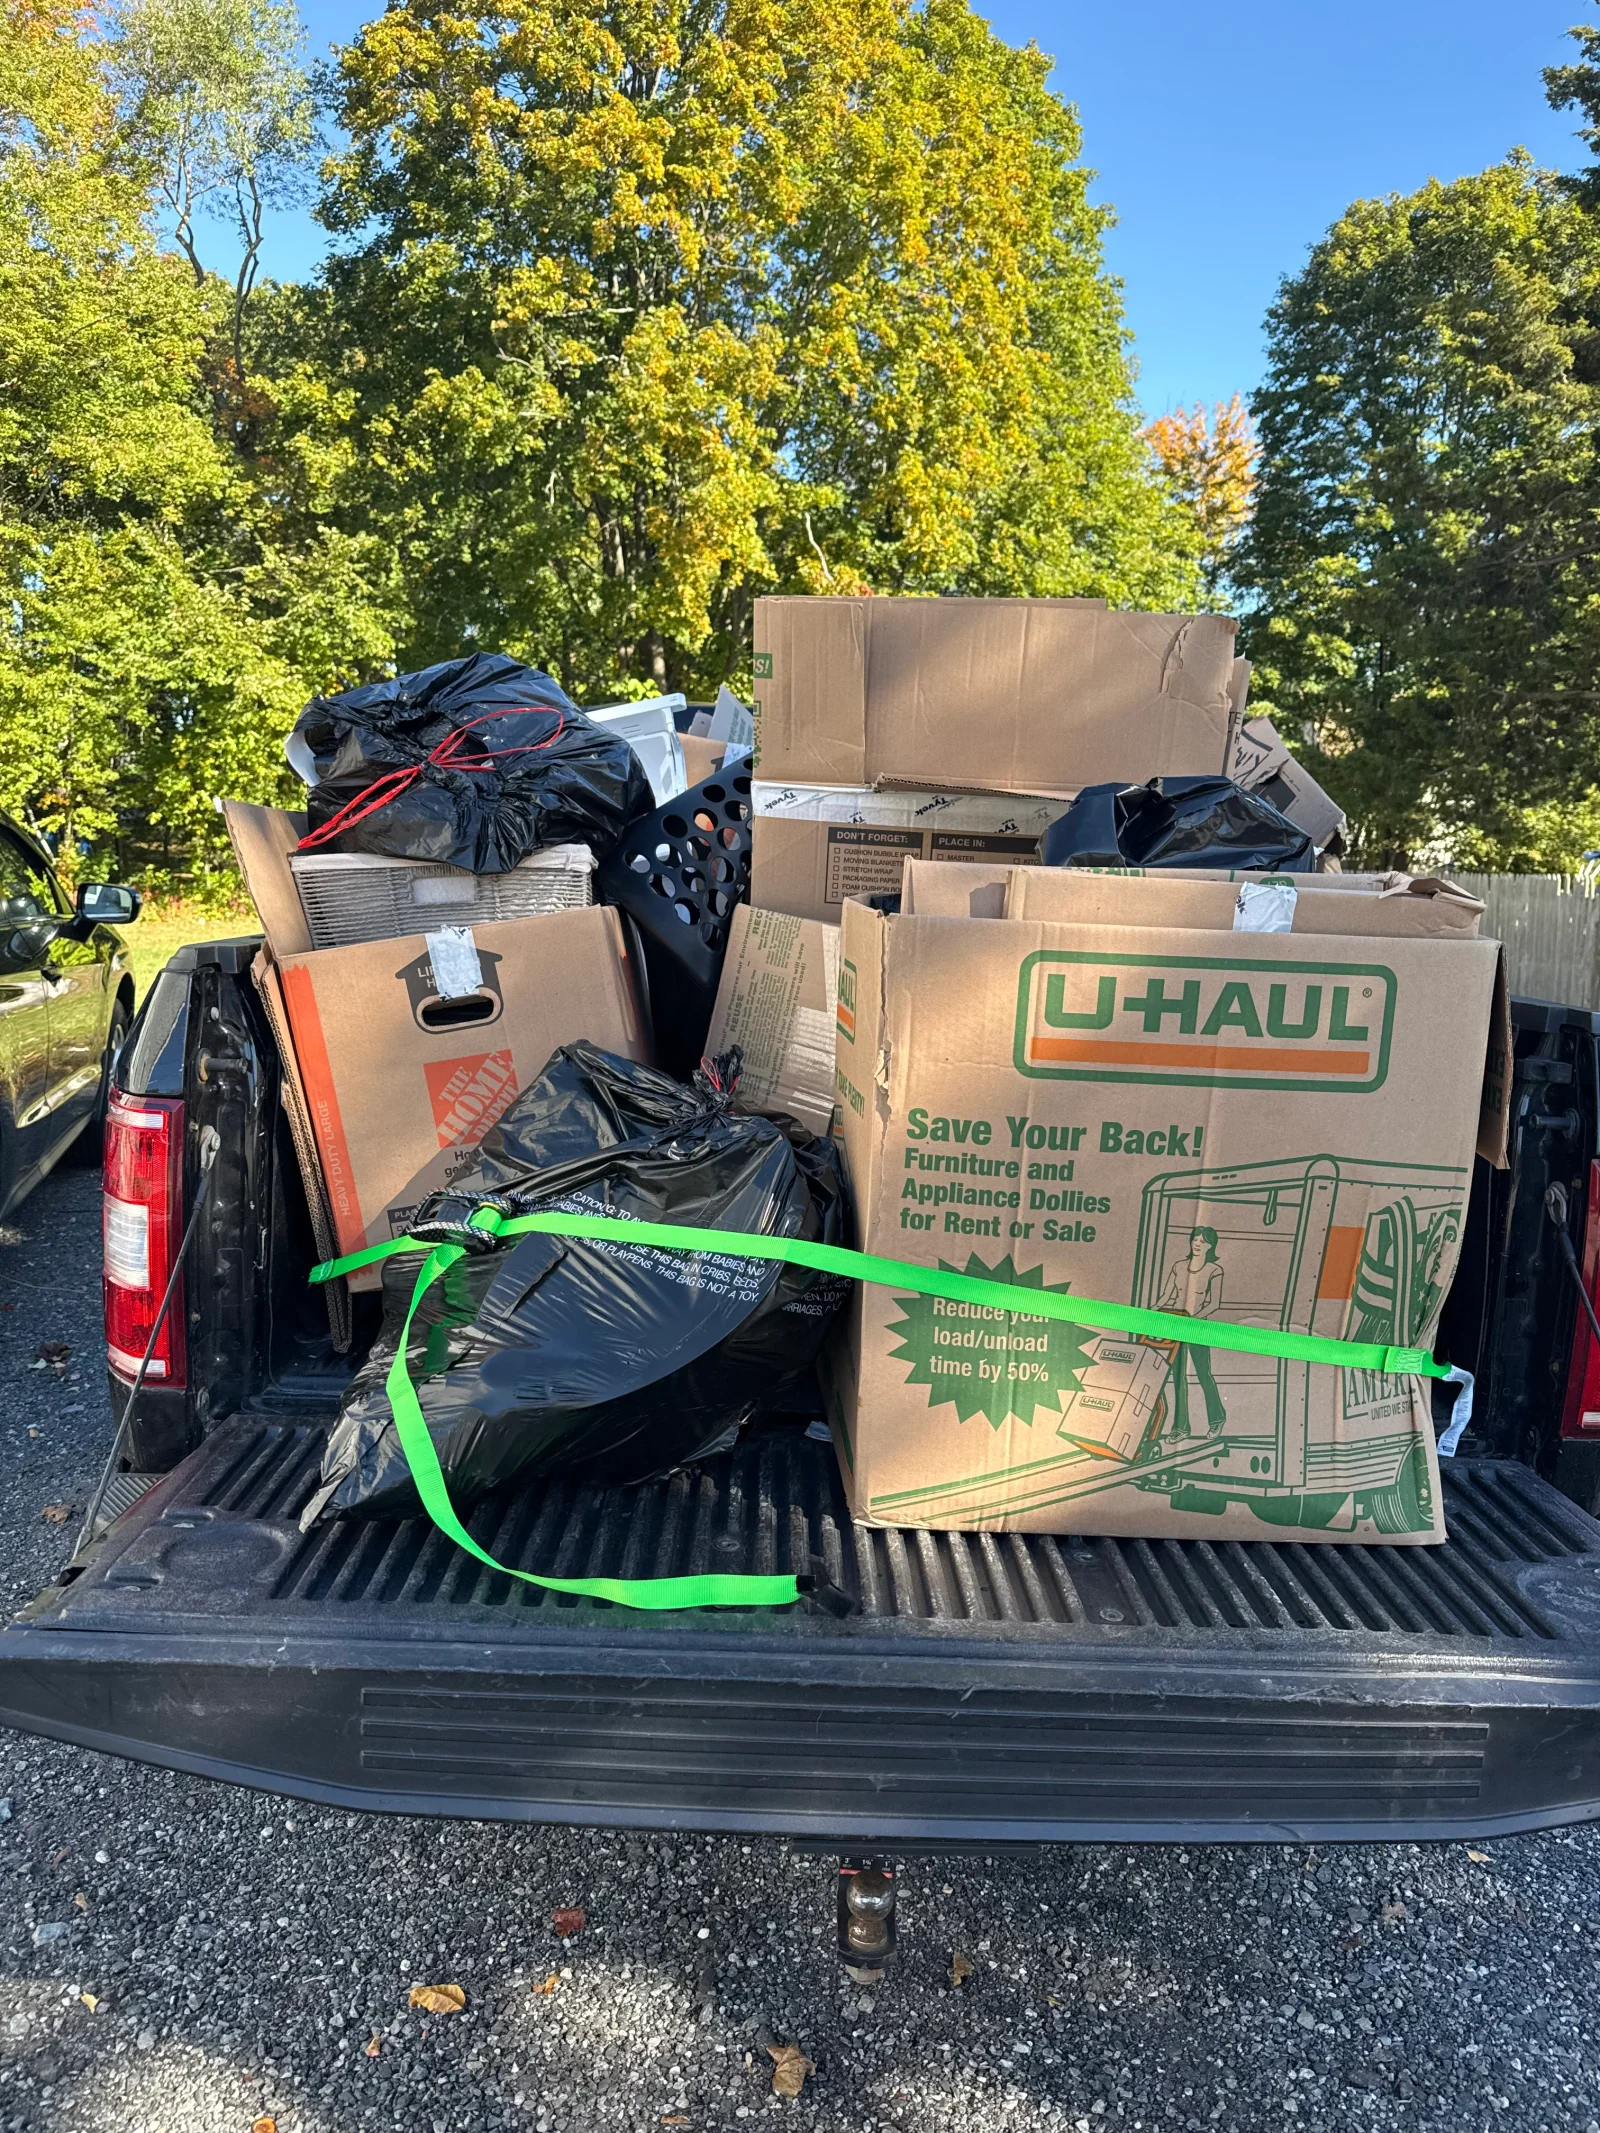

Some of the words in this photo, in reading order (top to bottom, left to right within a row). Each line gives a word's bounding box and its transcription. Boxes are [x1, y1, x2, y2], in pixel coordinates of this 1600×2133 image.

[837, 831, 864, 841] DON'T
[868, 834, 908, 844] FORGET:
[844, 848, 872, 856] CUSHION
[874, 850, 899, 858] BUBBLE
[939, 837, 970, 847] PLACE
[973, 839, 985, 847] IN:
[843, 857, 869, 865] MOVING
[871, 859, 904, 867] BLANKETS
[1023, 858, 1040, 866] KITC
[730, 994, 744, 1032] REUSE
[764, 1081, 773, 1104] orking
[778, 1019, 787, 1044] U-Haul
[783, 976, 797, 1017] Customers
[437, 1052, 515, 1146] HOME
[439, 1066, 472, 1104] THE
[318, 1101, 334, 1140] LARGE
[906, 1107, 992, 1146] Save
[1006, 1115, 1087, 1151] Your
[1099, 1121, 1204, 1158] Back!
[327, 1144, 342, 1176] DUTY
[904, 1147, 1020, 1178] Furniture
[1027, 1159, 1075, 1182] and
[335, 1182, 351, 1216] HEAVY
[901, 1177, 1021, 1209] Appliance
[1030, 1188, 1111, 1214] Dollies
[900, 1207, 936, 1231] for
[944, 1211, 1001, 1238] Rent
[1009, 1220, 1034, 1240] or
[1042, 1218, 1096, 1243] Sale
[592, 1239, 608, 1252] OR
[606, 1243, 652, 1270] PLAYPENS.
[655, 1264, 679, 1281] THIS
[676, 1274, 697, 1288] BAG
[696, 1277, 707, 1289] IS
[706, 1281, 731, 1296] NOT
[727, 1290, 737, 1300] A
[739, 1291, 759, 1303] TOY.
[629, 1244, 652, 1257] USE
[650, 1249, 673, 1266] THIS
[671, 1258, 690, 1272] BAG
[690, 1263, 701, 1274] IN
[700, 1265, 731, 1284] CRIBS,
[711, 1254, 746, 1273] BABIES
[932, 1297, 1005, 1321] Reduce
[933, 1327, 1048, 1352] load/unload
[1101, 1350, 1134, 1361] U-HAUL
[929, 1355, 973, 1377] time
[978, 1359, 1002, 1383] by
[1007, 1362, 1050, 1382] 50%
[1081, 1397, 1114, 1409] U-HAUL
[1370, 1404, 1392, 1421] UNITED
[1391, 1402, 1402, 1416] WE
[1401, 1400, 1415, 1414] STA
